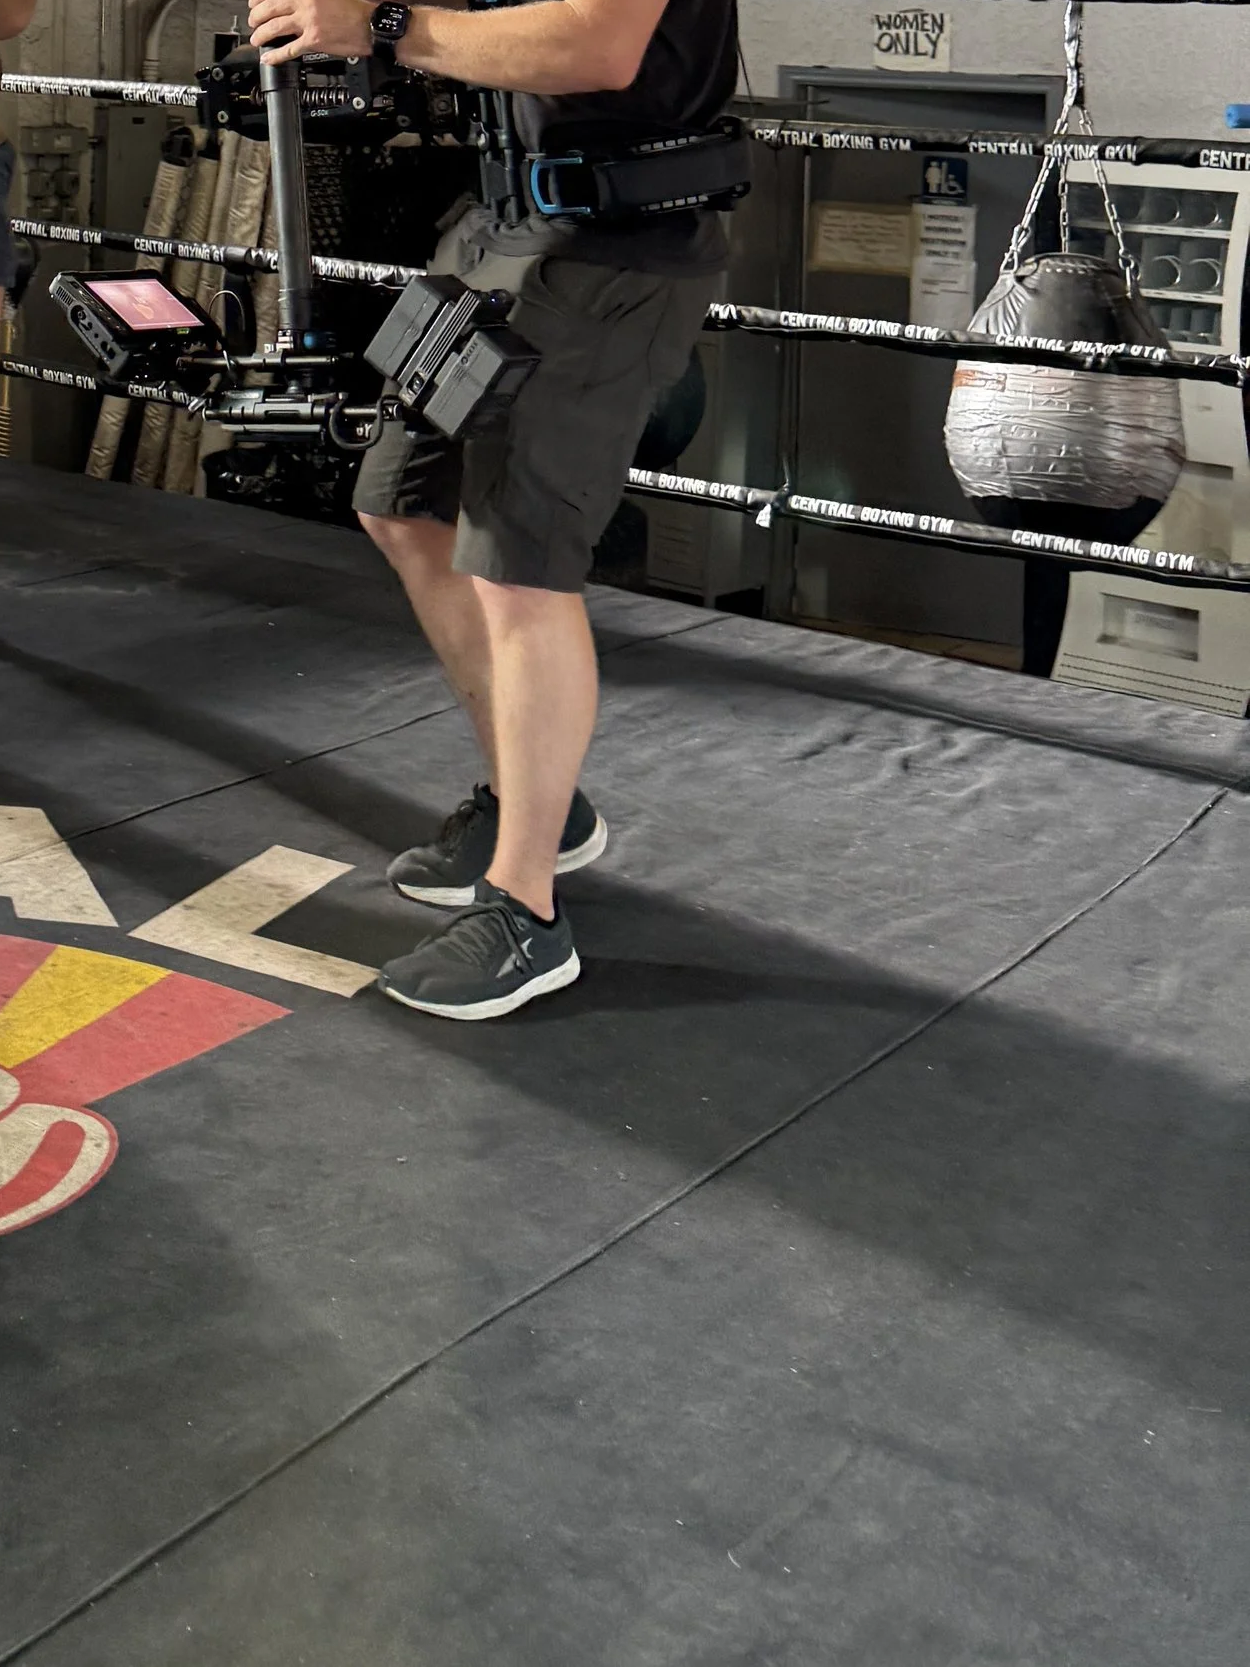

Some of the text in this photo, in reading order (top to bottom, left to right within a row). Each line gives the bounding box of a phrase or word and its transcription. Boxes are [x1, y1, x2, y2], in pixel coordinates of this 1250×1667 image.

[875, 13, 944, 34] WOMEN
[876, 32, 942, 59] ONLY
[822, 133, 873, 150] BOXING
[880, 137, 911, 151] GYM
[50, 225, 80, 242] BOXING
[83, 230, 102, 244] GYM
[134, 238, 175, 256] CENTRAL
[779, 310, 939, 341] CENTRAL BOXING GYM
[43, 368, 73, 385] BOXING
[76, 375, 97, 390] GYM
[658, 473, 705, 494] BOXING
[710, 481, 741, 500] GYM
[790, 494, 954, 534] CENTRAL BOXING GYM
[1011, 529, 1195, 572] CENTRAL BOXING GYM
